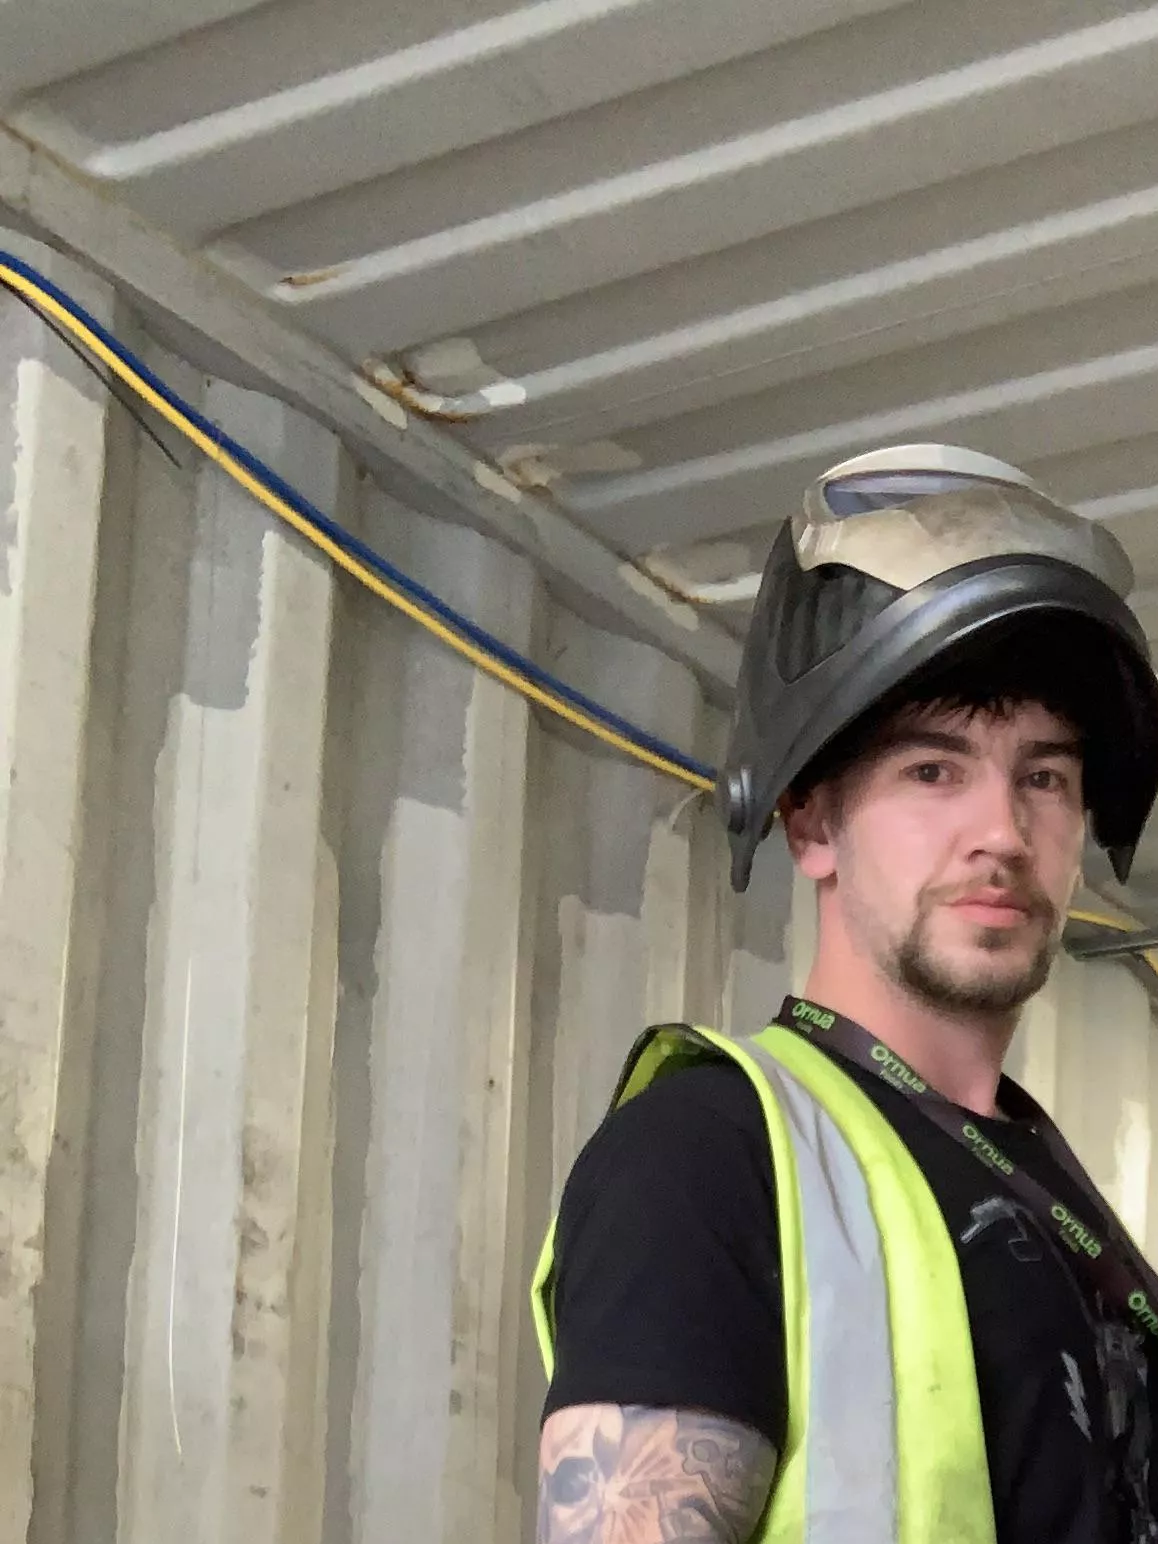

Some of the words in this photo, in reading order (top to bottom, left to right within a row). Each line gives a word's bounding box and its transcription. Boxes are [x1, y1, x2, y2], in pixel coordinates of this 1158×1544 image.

[792, 1002, 835, 1030] Ornua
[871, 1045, 926, 1093] Ornua
[962, 1125, 1014, 1175] Ornua
[1052, 1206, 1102, 1259] Ornua
